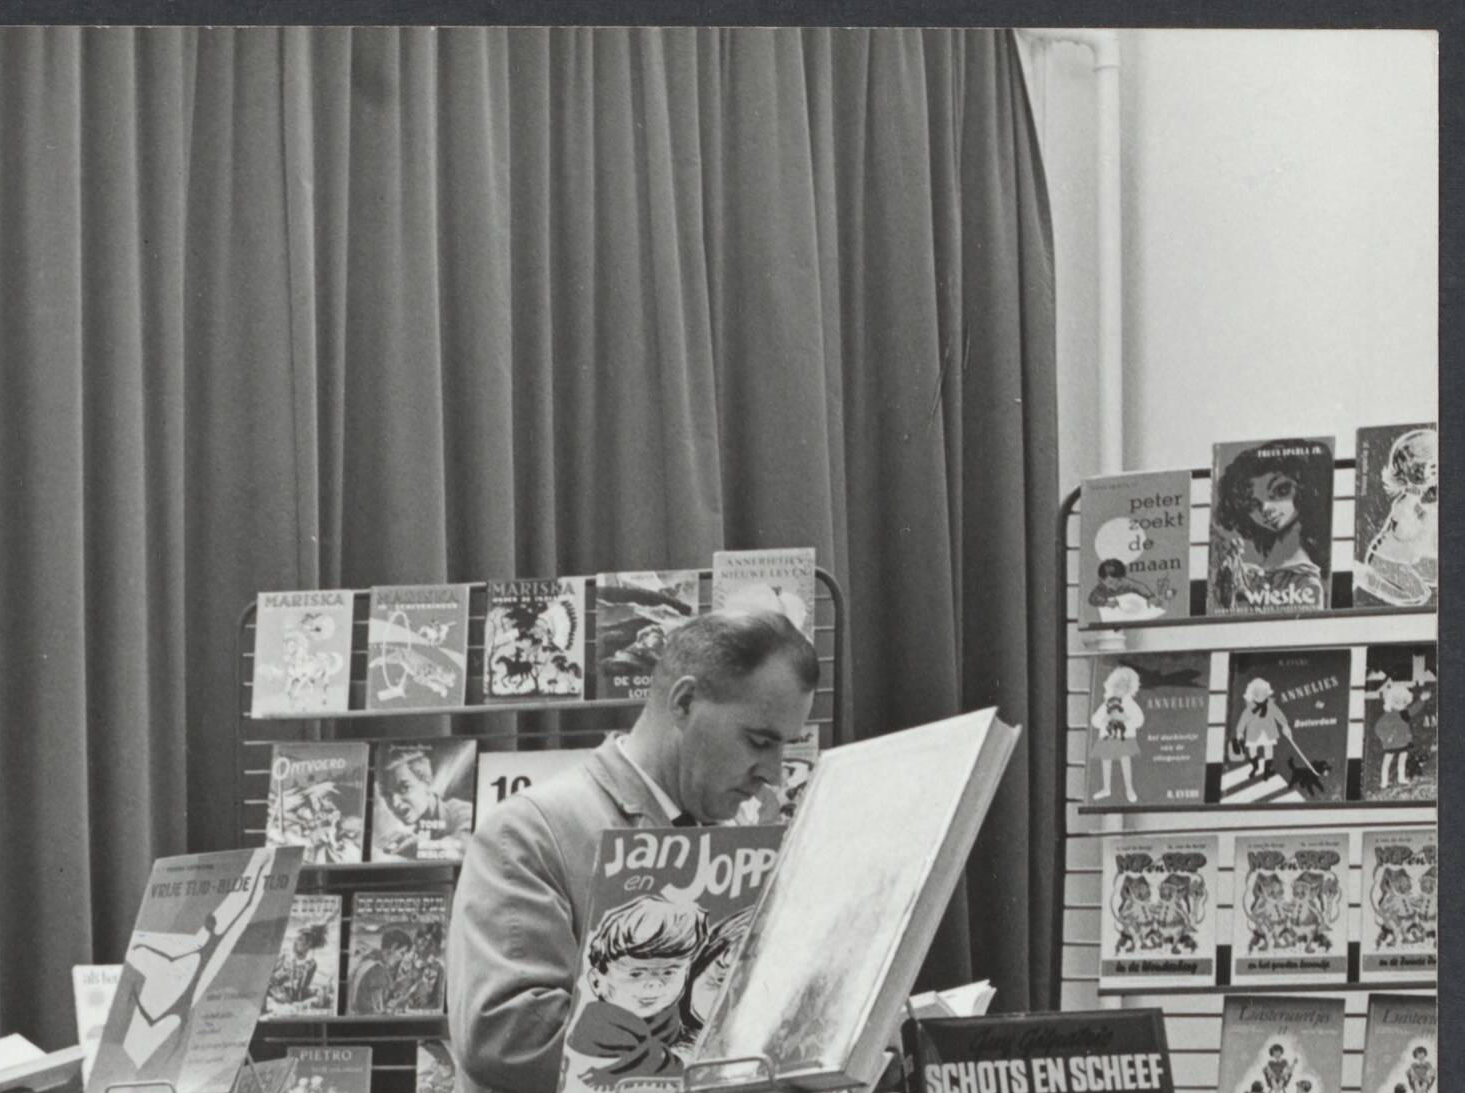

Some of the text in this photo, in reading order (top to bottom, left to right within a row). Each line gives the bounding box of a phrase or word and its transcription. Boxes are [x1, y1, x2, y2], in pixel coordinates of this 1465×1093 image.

[1129, 492, 1183, 514] peter
[1128, 509, 1184, 531] zoekt
[1128, 534, 1154, 552] de
[1129, 557, 1182, 573] maan
[377, 590, 461, 605] MARISKA
[492, 581, 576, 597] MARISKA
[1245, 582, 1315, 605] wieske
[265, 593, 345, 608] MARISKA
[613, 675, 654, 687] DE GO
[1280, 675, 1339, 704] ANNELIES
[628, 688, 649, 700] LOT
[1147, 696, 1204, 709] ANNELIES
[272, 757, 347, 780] ONTVOERD
[623, 874, 655, 892] en
[300, 1050, 352, 1062] PIETRO
[1069, 1053, 1164, 1093] SCHEEF
